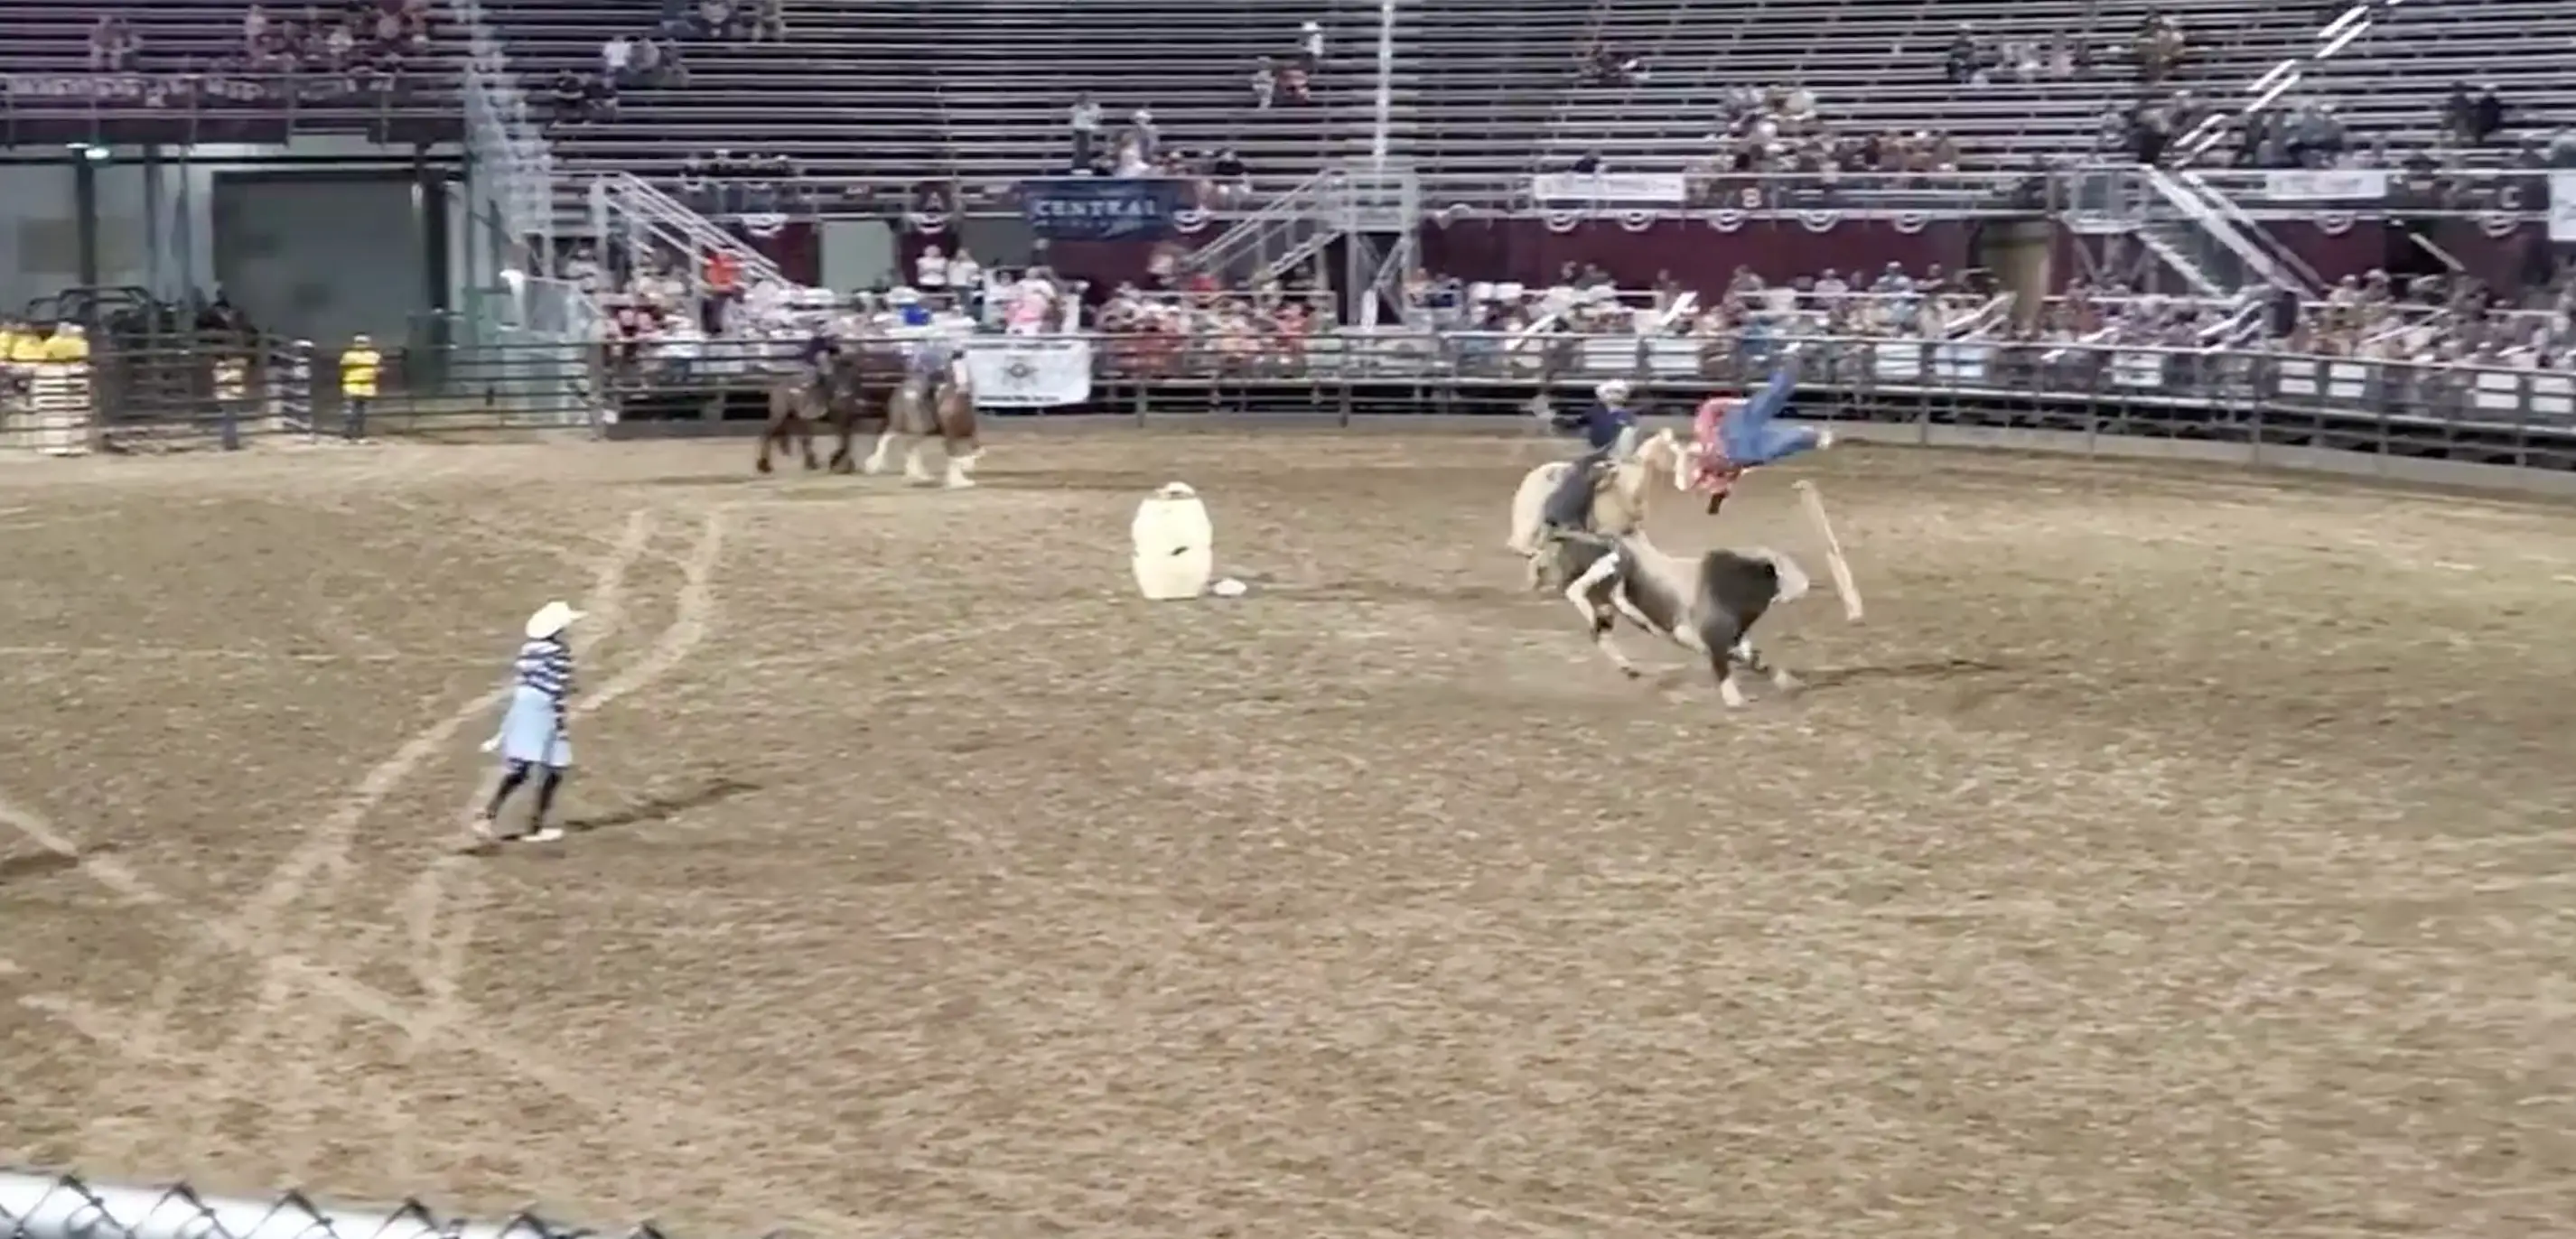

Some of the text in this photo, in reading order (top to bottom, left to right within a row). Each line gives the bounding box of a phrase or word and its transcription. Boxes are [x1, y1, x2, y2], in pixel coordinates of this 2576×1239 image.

[925, 191, 945, 210] A
[2501, 186, 2522, 209] C
[1038, 200, 1157, 218] CENTRAL
